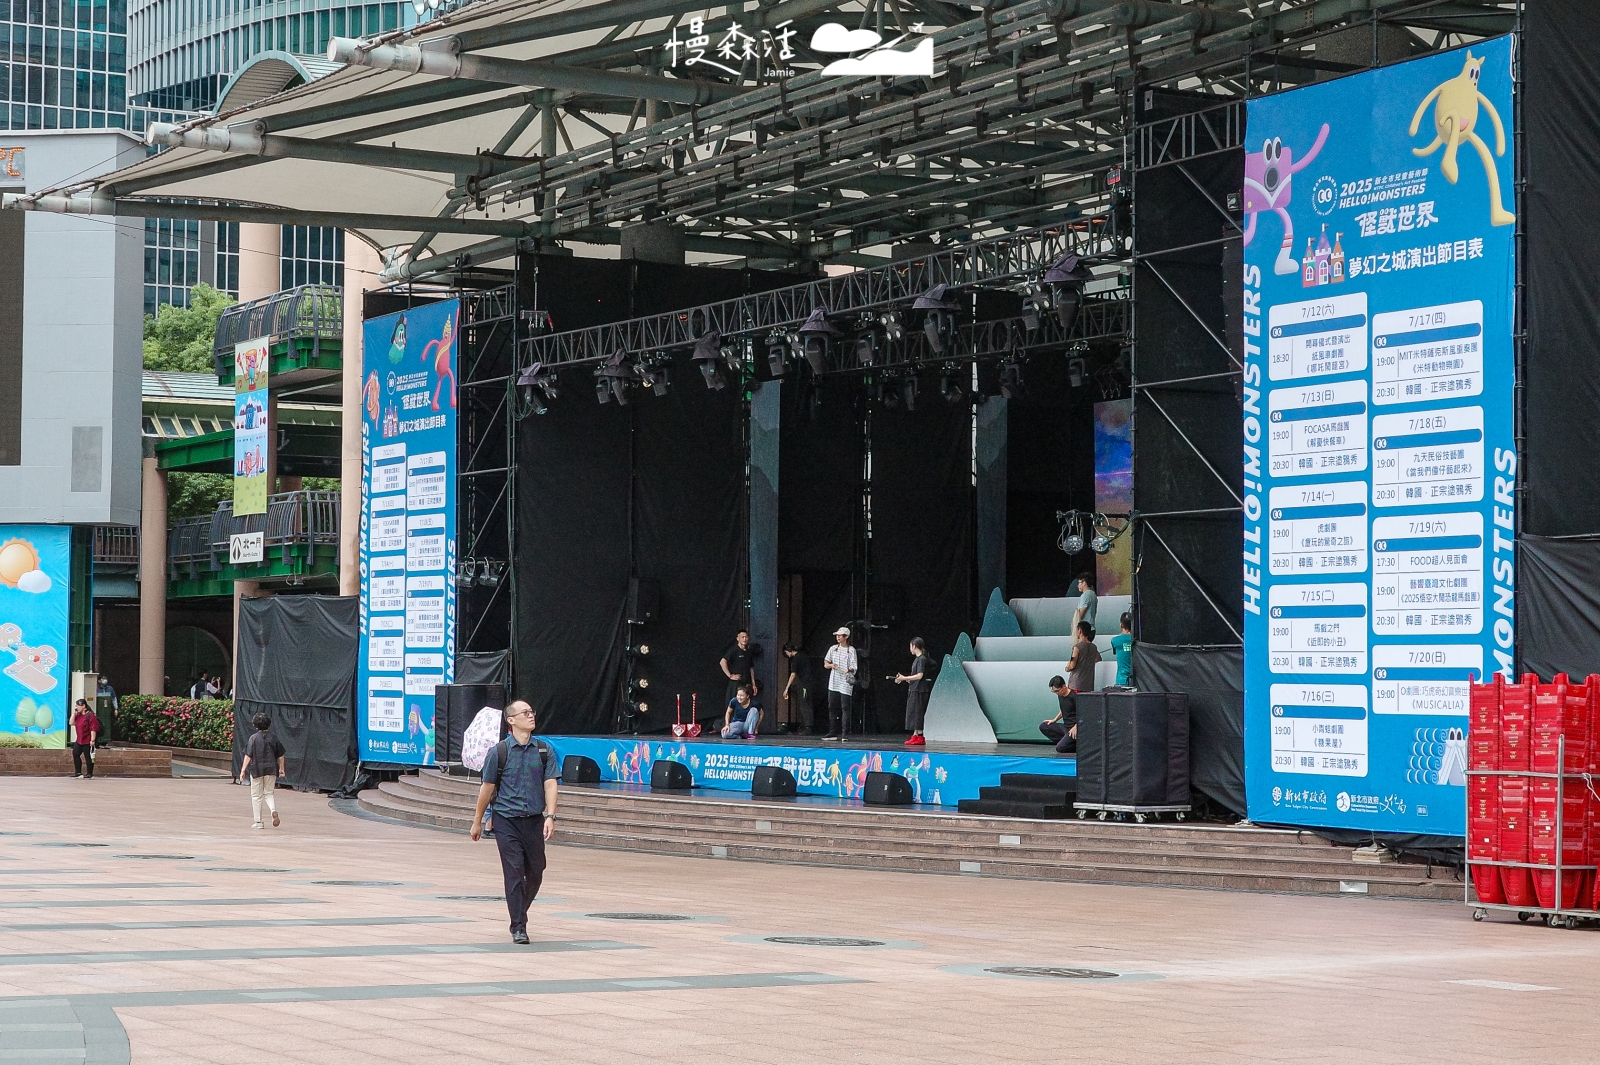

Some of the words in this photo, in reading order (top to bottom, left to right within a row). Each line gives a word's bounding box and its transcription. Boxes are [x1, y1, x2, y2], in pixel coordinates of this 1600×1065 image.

[1374, 168, 1428, 185] 新北市兒童藝術節
[1340, 178, 1372, 197] 2025
[1339, 183, 1426, 209] HELLO!MONSTERS
[1355, 201, 1438, 237] 怪獸世界
[1348, 238, 1484, 278] 夢幻之城演出節目表
[1302, 304, 1334, 318] 7/12(六)
[1409, 312, 1446, 327] 7/17(四)
[1272, 354, 1289, 363] 18:30
[1312, 348, 1344, 361] 紙風車劇團
[1376, 356, 1395, 366] 19:00
[1302, 390, 1334, 404] 7/13(日)
[1376, 388, 1395, 398] 20:30
[1409, 416, 1446, 430] 7/18(五)
[1244, 263, 1262, 616] HELLO!MONSTERS
[1272, 431, 1289, 440] 19:00
[1414, 449, 1464, 462] 九天民俗技藝團
[1272, 461, 1289, 470] 20:30
[1376, 459, 1395, 468] 19:00
[1302, 490, 1334, 503] 7/14(一)
[1376, 490, 1395, 499] 20:30
[360, 421, 370, 635] HELLO!MONSTERS
[1273, 529, 1289, 538] 19:00
[1409, 521, 1446, 534] 7/19(六)
[1272, 559, 1289, 568] 20:30
[1376, 558, 1395, 566] 17:30
[1410, 554, 1468, 566] FOOD超人見面會
[1302, 590, 1334, 602] 7/15(二)
[1376, 587, 1395, 595] 19:00
[1376, 616, 1395, 625] 20:30
[1273, 628, 1289, 636] 19:00
[1314, 624, 1340, 633] 馬戲之門
[1273, 658, 1289, 666] 20:30
[1409, 652, 1446, 664] 7/20(日)
[1302, 691, 1334, 703] 7/16(三)
[1376, 690, 1395, 698] 19:00
[1275, 726, 1291, 735] 19:00
[1312, 724, 1344, 734] 小青蛙劇團
[705, 754, 729, 767] 2025
[1275, 756, 1291, 765] 20:30
[1285, 788, 1326, 805] 新北市政府
[1351, 794, 1379, 805] 新北市政府
